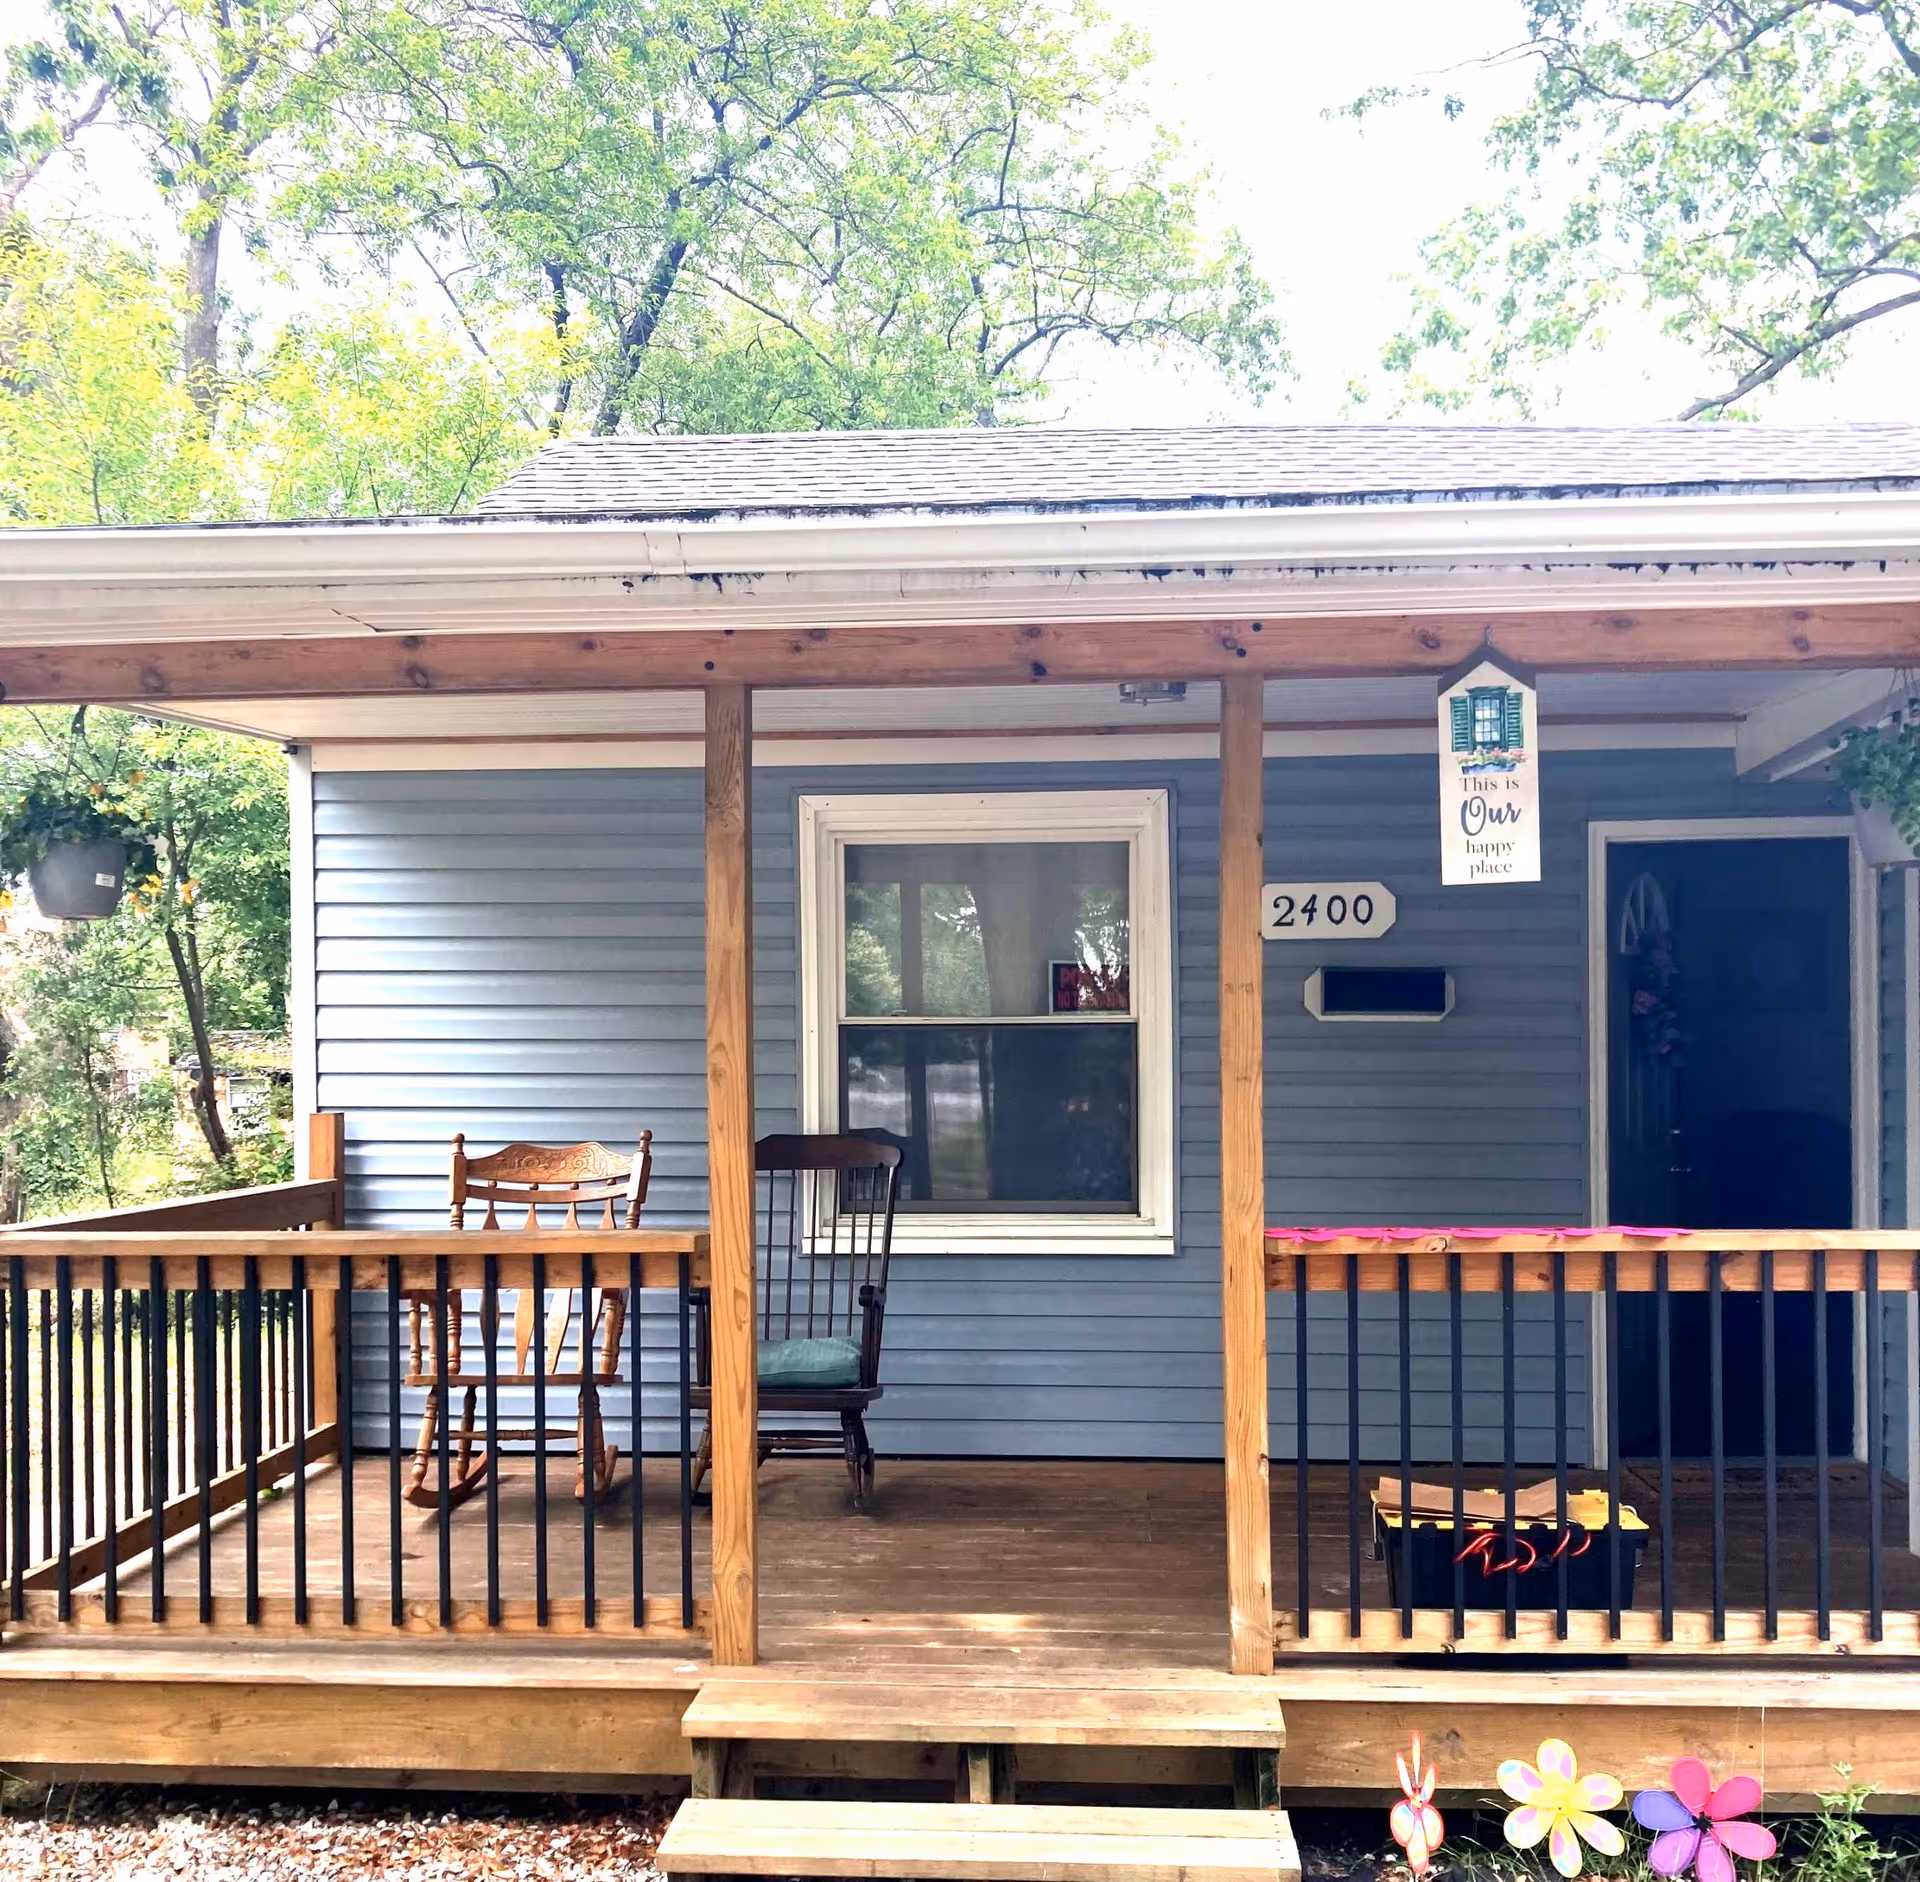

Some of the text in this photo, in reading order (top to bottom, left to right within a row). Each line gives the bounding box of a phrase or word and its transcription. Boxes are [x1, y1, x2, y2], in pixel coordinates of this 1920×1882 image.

[1459, 776, 1520, 792] This is
[1460, 795, 1522, 837] Our
[1466, 838, 1515, 857] happy
[1469, 859, 1513, 879] place
[1272, 894, 1374, 927] 2400
